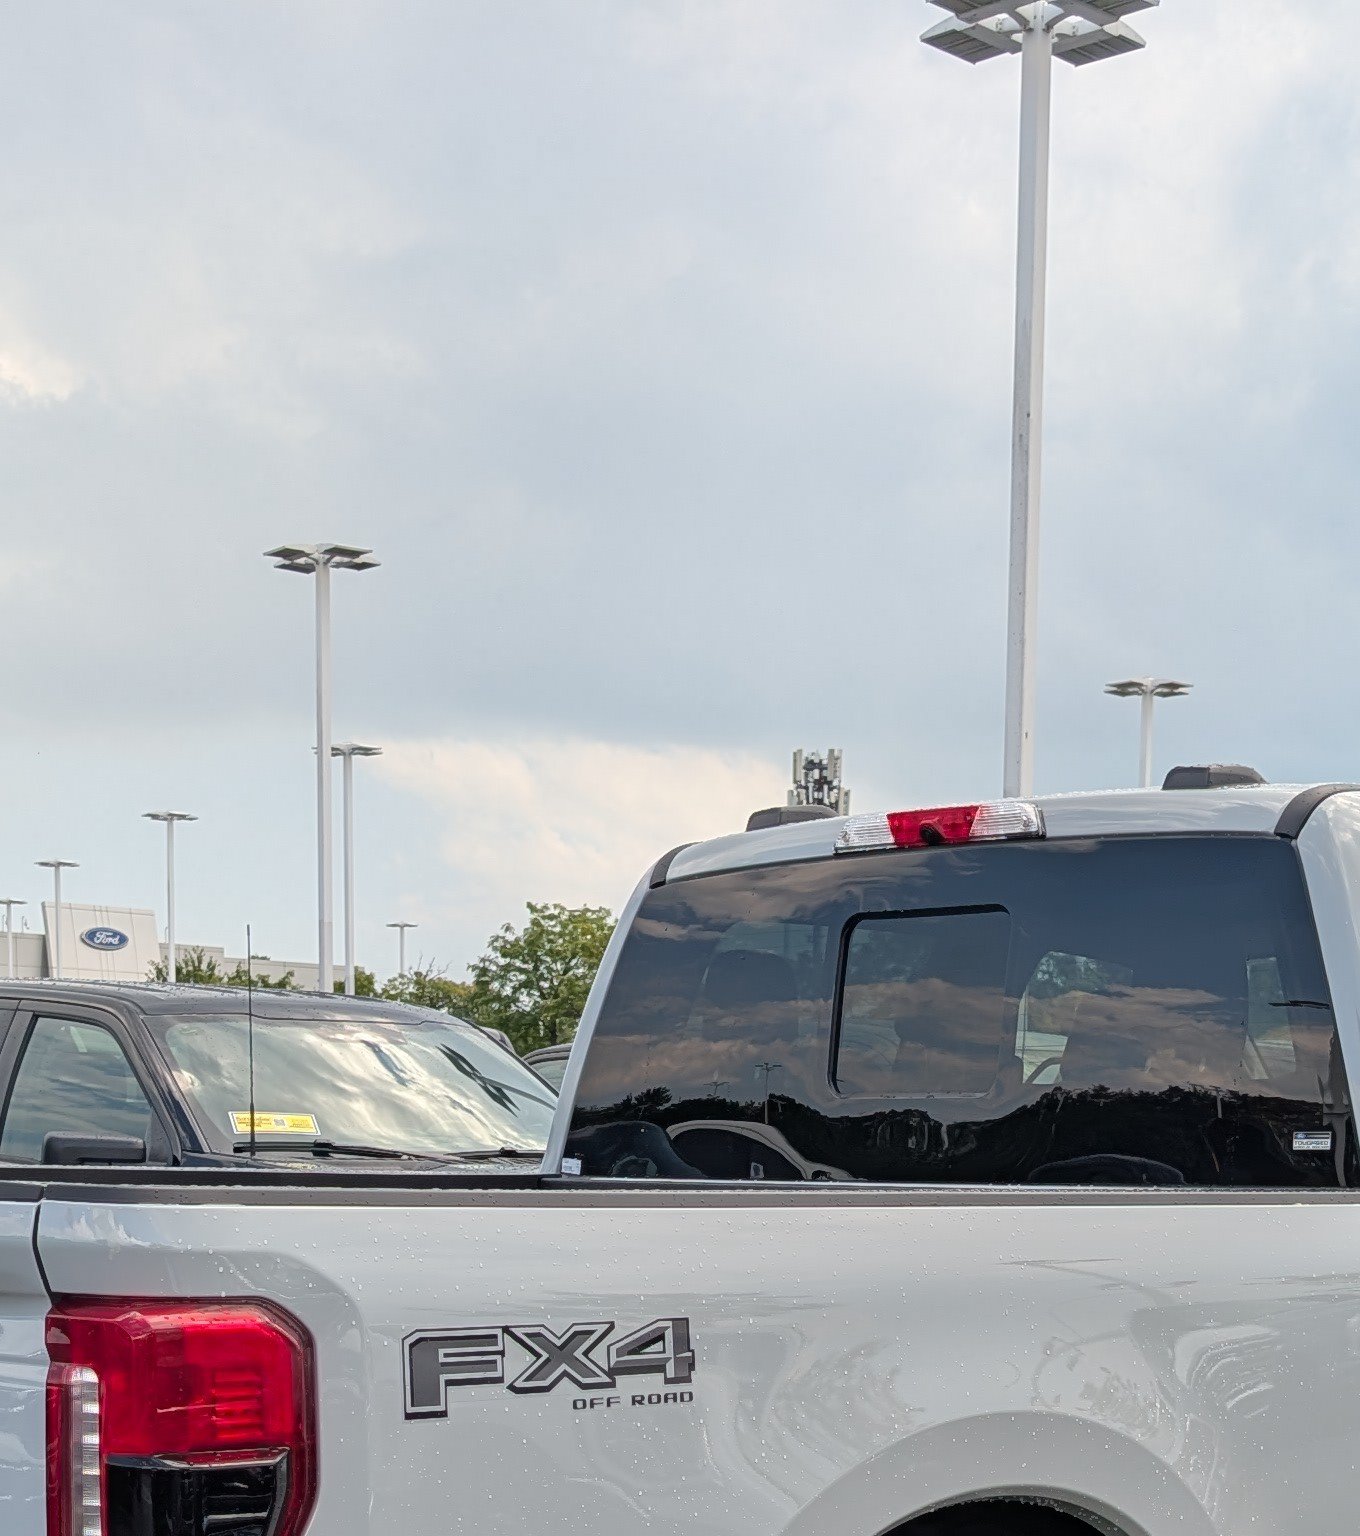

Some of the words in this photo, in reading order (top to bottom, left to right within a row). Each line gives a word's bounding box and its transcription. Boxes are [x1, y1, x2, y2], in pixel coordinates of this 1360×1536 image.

[94, 931, 120, 944] Ford
[402, 1317, 695, 1420] FX4
[573, 1396, 621, 1410] OFF
[632, 1391, 694, 1405] ROAD
